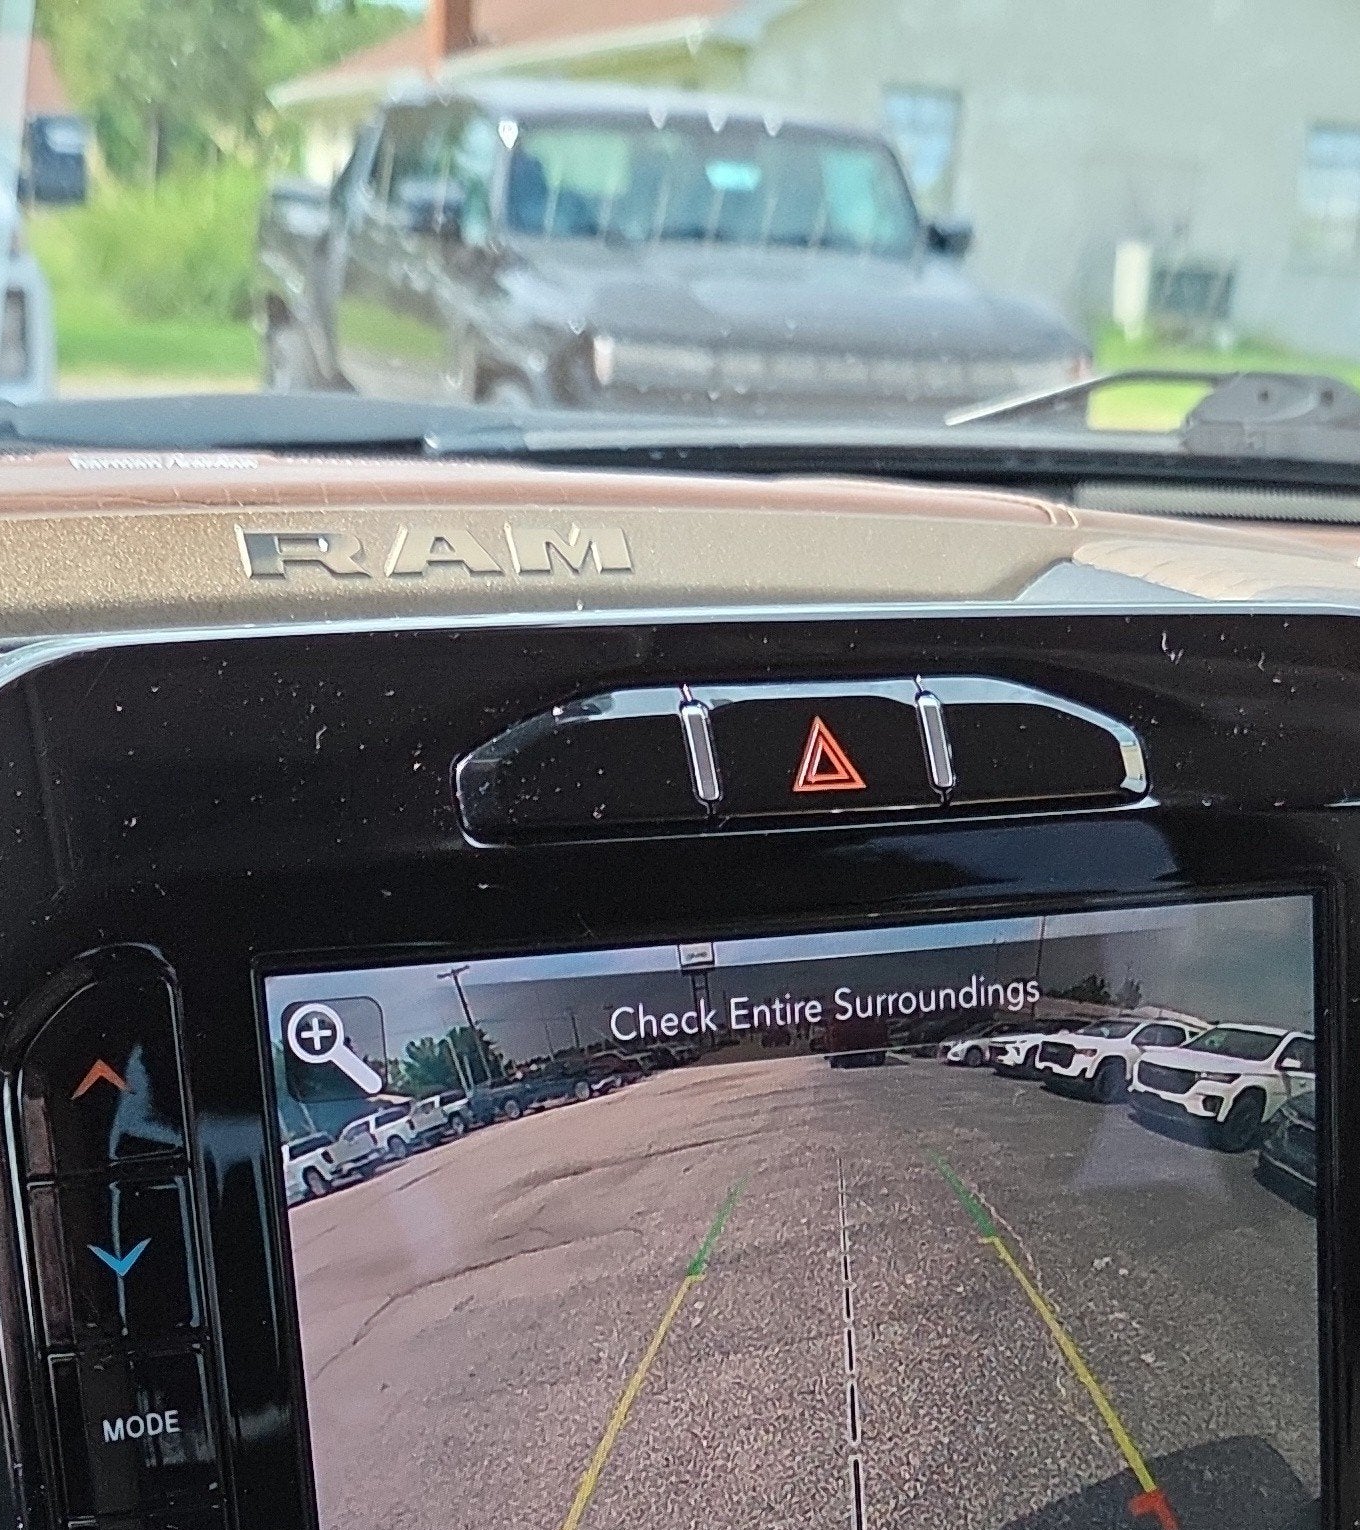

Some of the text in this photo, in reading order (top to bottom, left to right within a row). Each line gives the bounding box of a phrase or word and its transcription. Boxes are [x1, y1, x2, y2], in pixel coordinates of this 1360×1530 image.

[234, 523, 636, 580] RAM
[610, 974, 1040, 1042] Check Entire Surroundings
[102, 1410, 181, 1443] MODE
